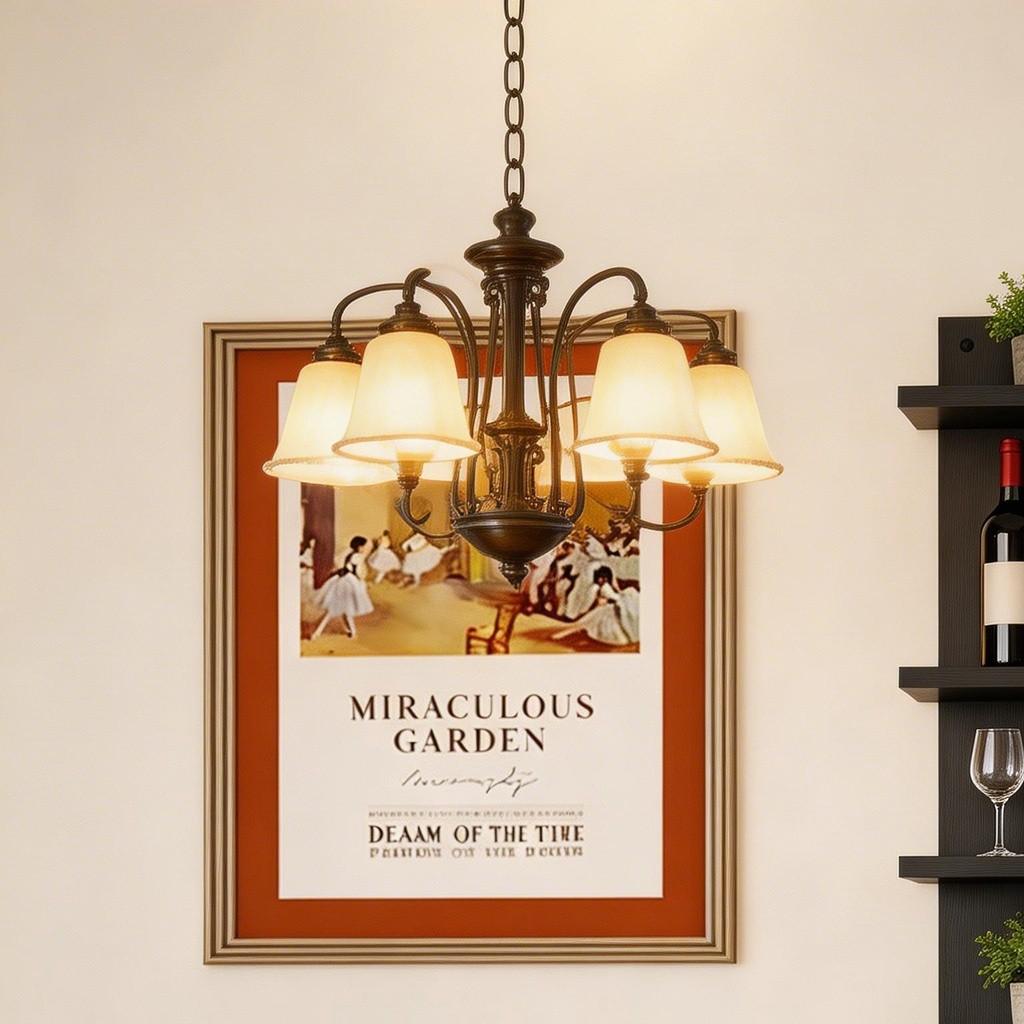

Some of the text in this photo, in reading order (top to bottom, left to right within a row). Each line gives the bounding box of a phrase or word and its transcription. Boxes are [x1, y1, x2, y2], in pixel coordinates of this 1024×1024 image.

[350, 693, 594, 720] MIRACULOUS
[393, 727, 546, 753] GARDEN
[453, 824, 483, 844] OF
[488, 824, 526, 843] THE
